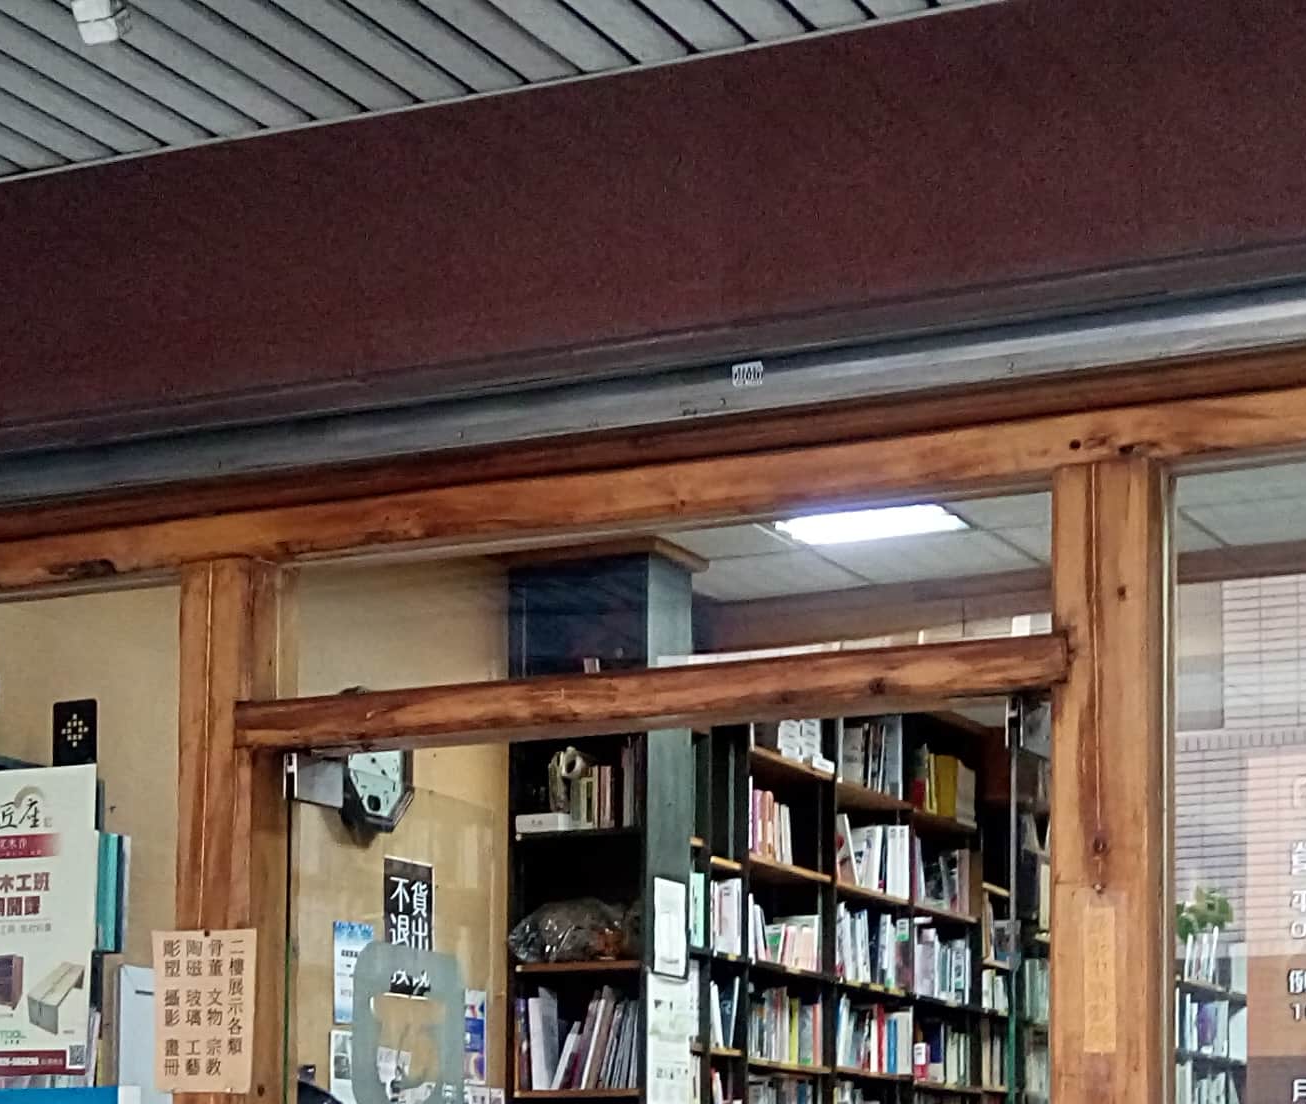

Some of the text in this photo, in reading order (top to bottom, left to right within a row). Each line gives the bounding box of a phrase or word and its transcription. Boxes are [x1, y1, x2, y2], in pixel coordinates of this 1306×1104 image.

[185, 988, 202, 1027] 玻璃
[205, 939, 224, 1077] 骨董 文物 宗教
[227, 939, 245, 1055] 二樓展示各類
